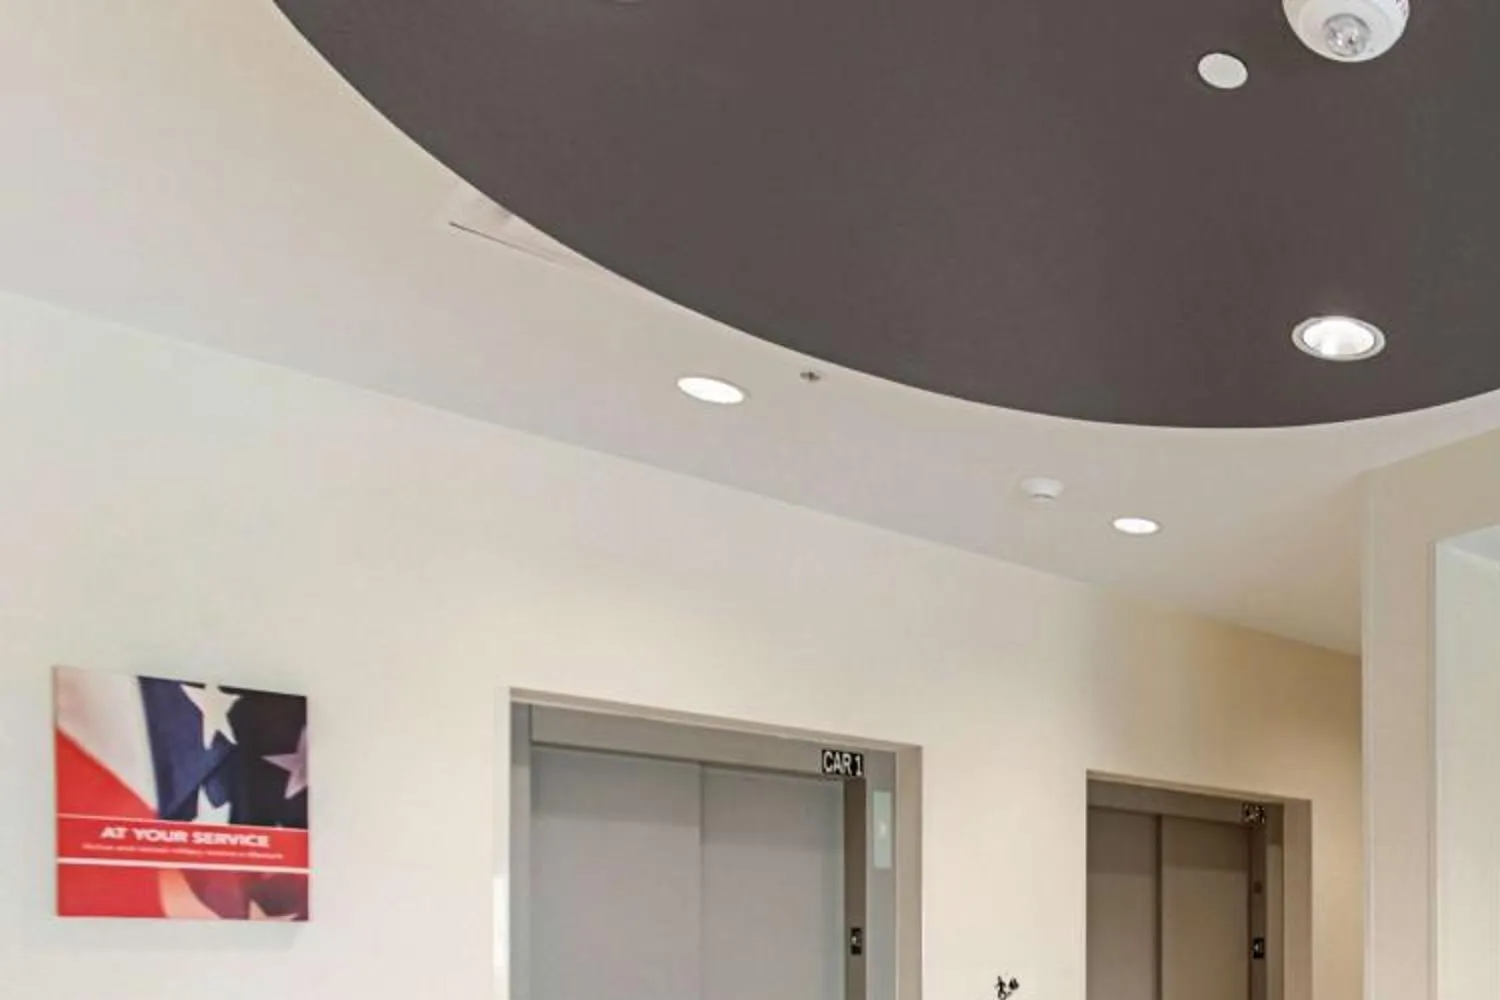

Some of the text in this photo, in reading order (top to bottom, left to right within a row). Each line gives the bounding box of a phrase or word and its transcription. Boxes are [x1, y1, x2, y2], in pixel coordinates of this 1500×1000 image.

[824, 751, 862, 776] CAR 1
[101, 827, 270, 848] AT YOUR SERVICE
